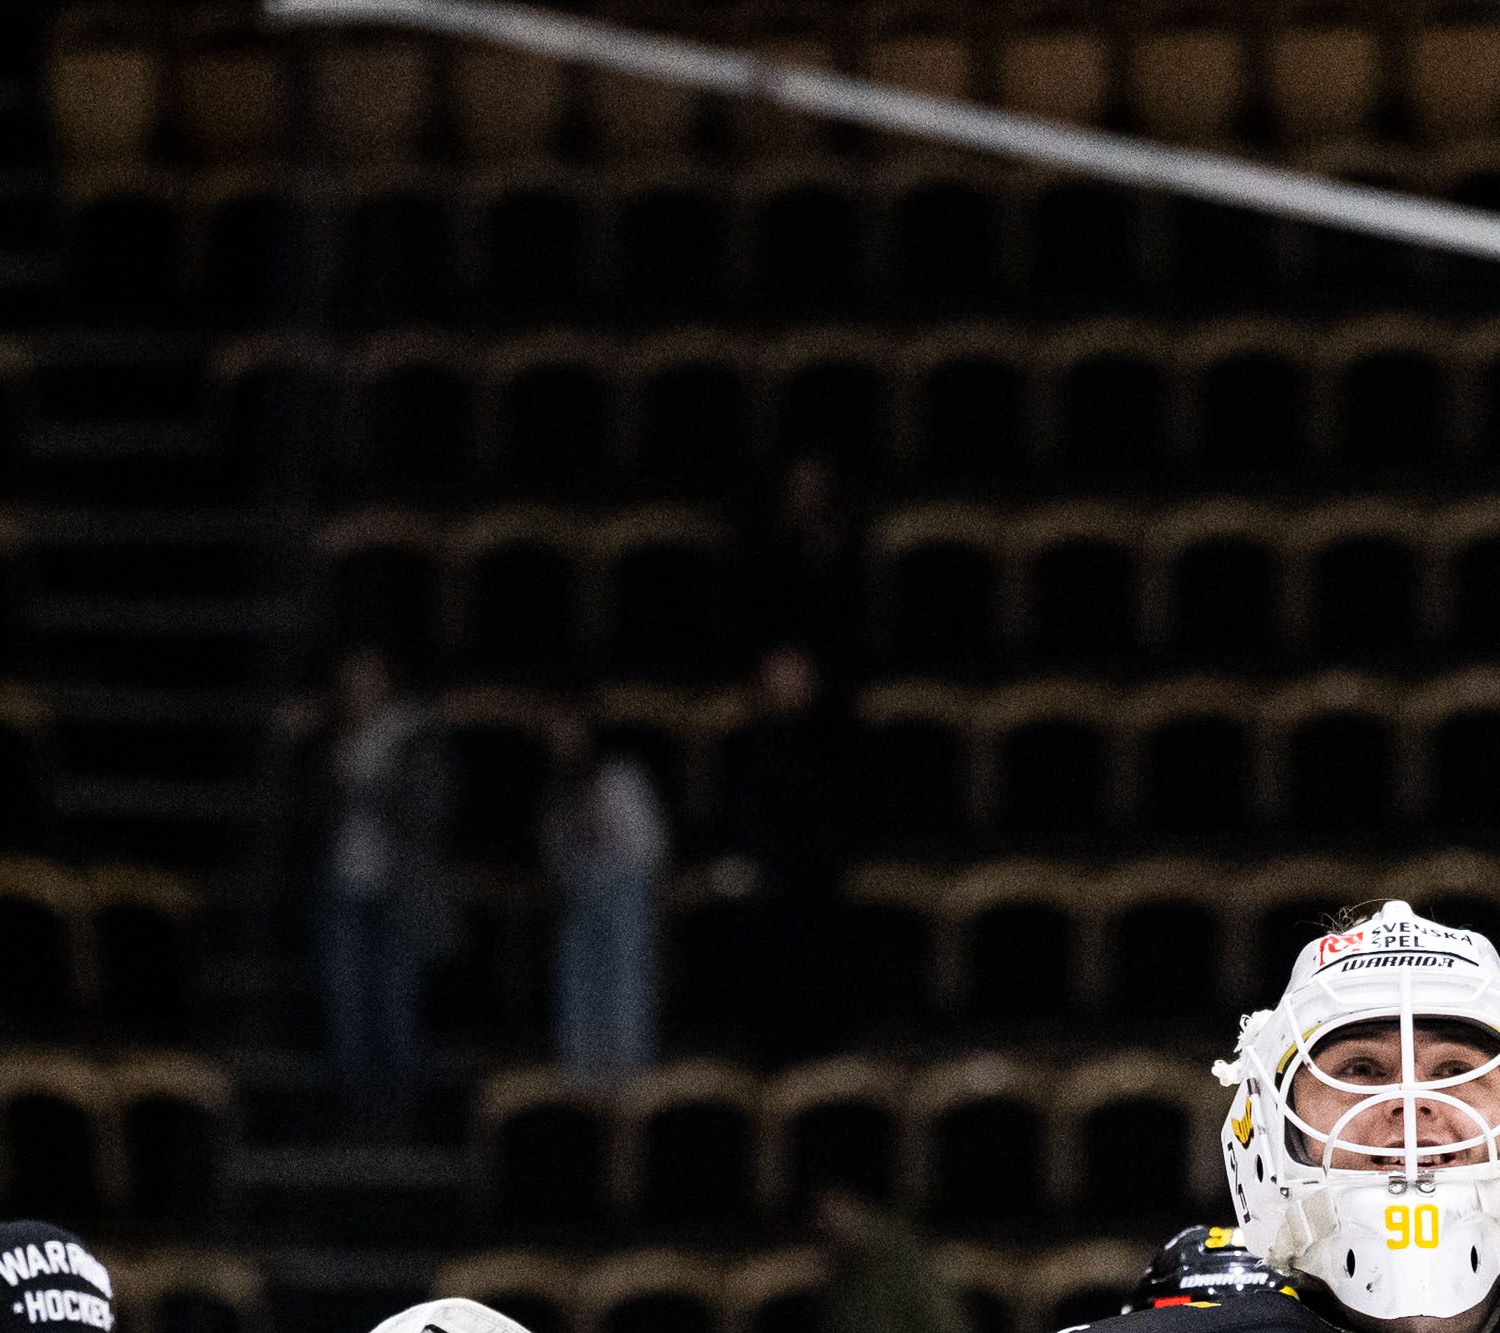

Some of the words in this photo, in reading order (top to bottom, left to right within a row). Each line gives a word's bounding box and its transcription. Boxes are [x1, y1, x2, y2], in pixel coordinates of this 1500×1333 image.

[1372, 935, 1425, 948] SPEL
[1341, 955, 1455, 973] WARRIOR
[1384, 1204, 1440, 1250] 90
